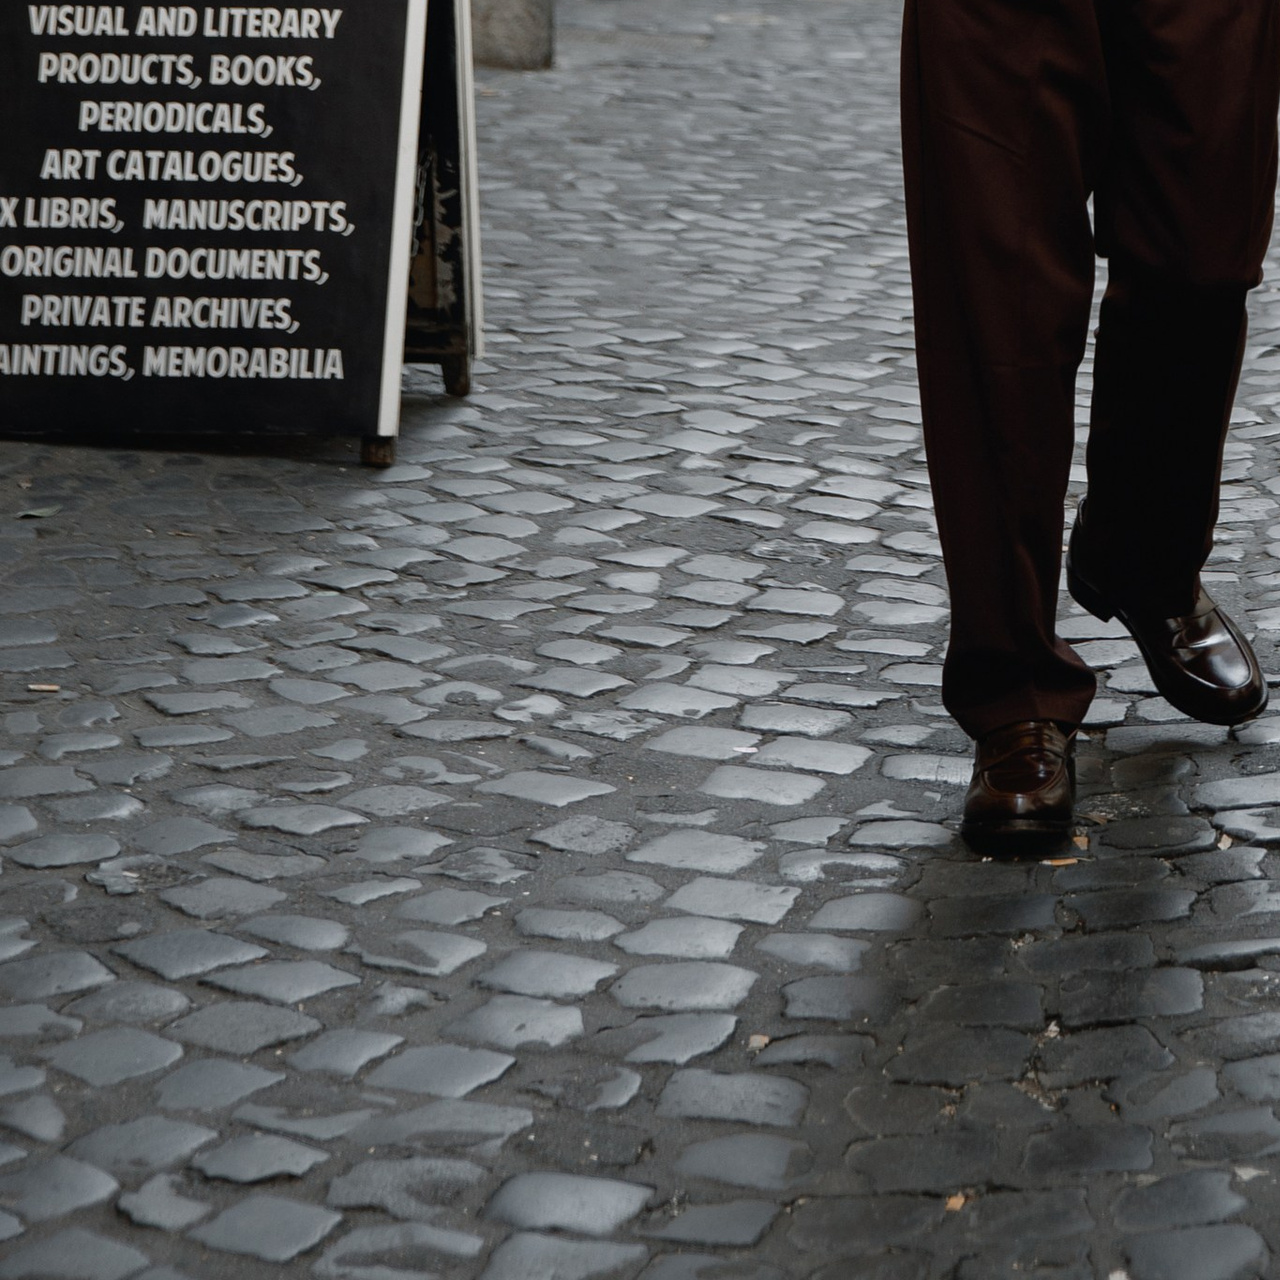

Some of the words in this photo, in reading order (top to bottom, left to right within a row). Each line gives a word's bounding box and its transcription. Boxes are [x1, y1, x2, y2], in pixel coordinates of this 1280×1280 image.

[28, 4, 130, 36] VISUAL
[135, 6, 198, 37] AND
[203, 7, 343, 39] LITERARY
[37, 52, 202, 90] PRODUCTS,
[209, 54, 322, 91] BOOKS,
[78, 100, 274, 139] PERIODICALS,
[40, 148, 102, 180] ART
[106, 149, 304, 187] CATALOGUES,
[0, 196, 19, 228] X
[23, 197, 125, 234] LIBRIS,
[143, 198, 355, 237] MANUSCRIPTS,
[0, 245, 139, 278] ORIGINAL
[144, 247, 330, 285] DOCUMENTS,
[21, 294, 147, 328] PRIVATE
[150, 296, 300, 334] ARCHIVES,
[0, 344, 136, 381] AINTINGS,
[142, 346, 345, 380] MEMORABILIA
